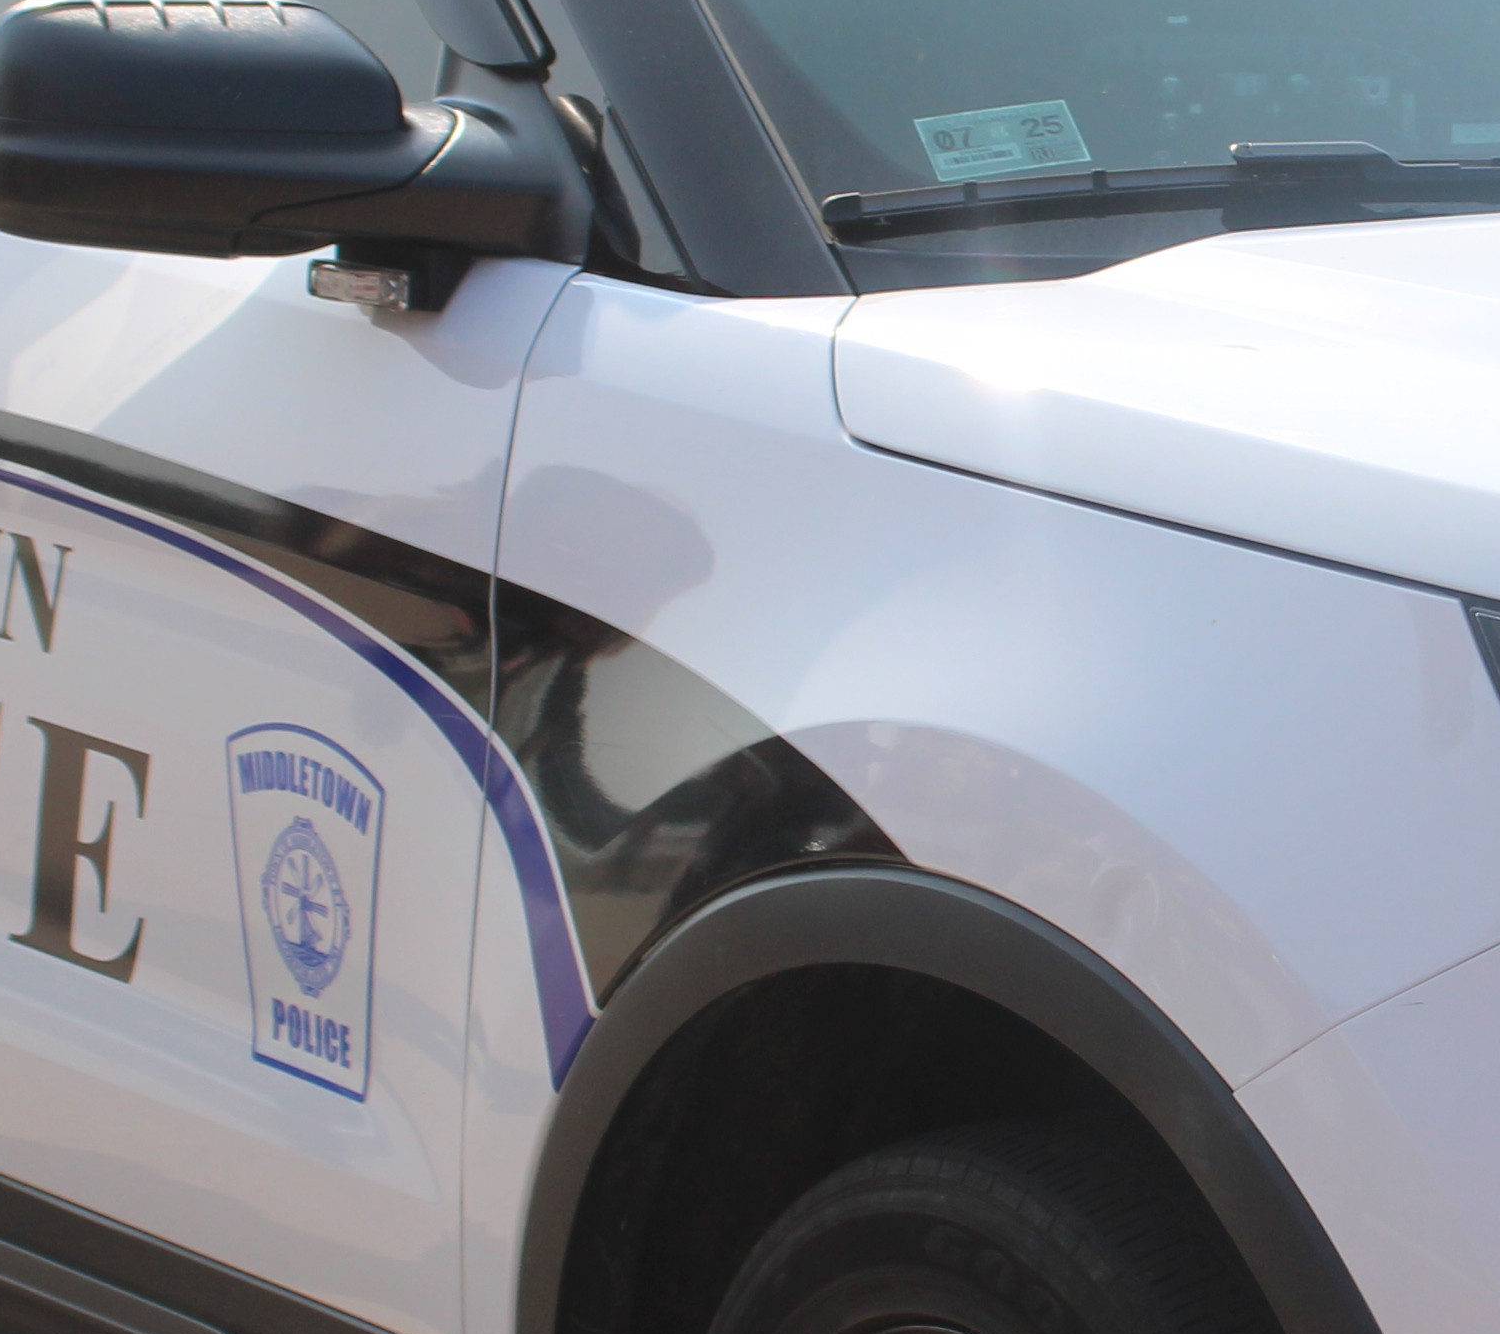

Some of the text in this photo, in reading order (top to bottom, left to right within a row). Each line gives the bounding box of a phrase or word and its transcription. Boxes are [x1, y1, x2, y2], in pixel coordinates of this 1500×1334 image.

[1020, 115, 1064, 138] 25
[236, 749, 372, 837] MIDDLETOWN
[271, 997, 351, 1069] POLICE
